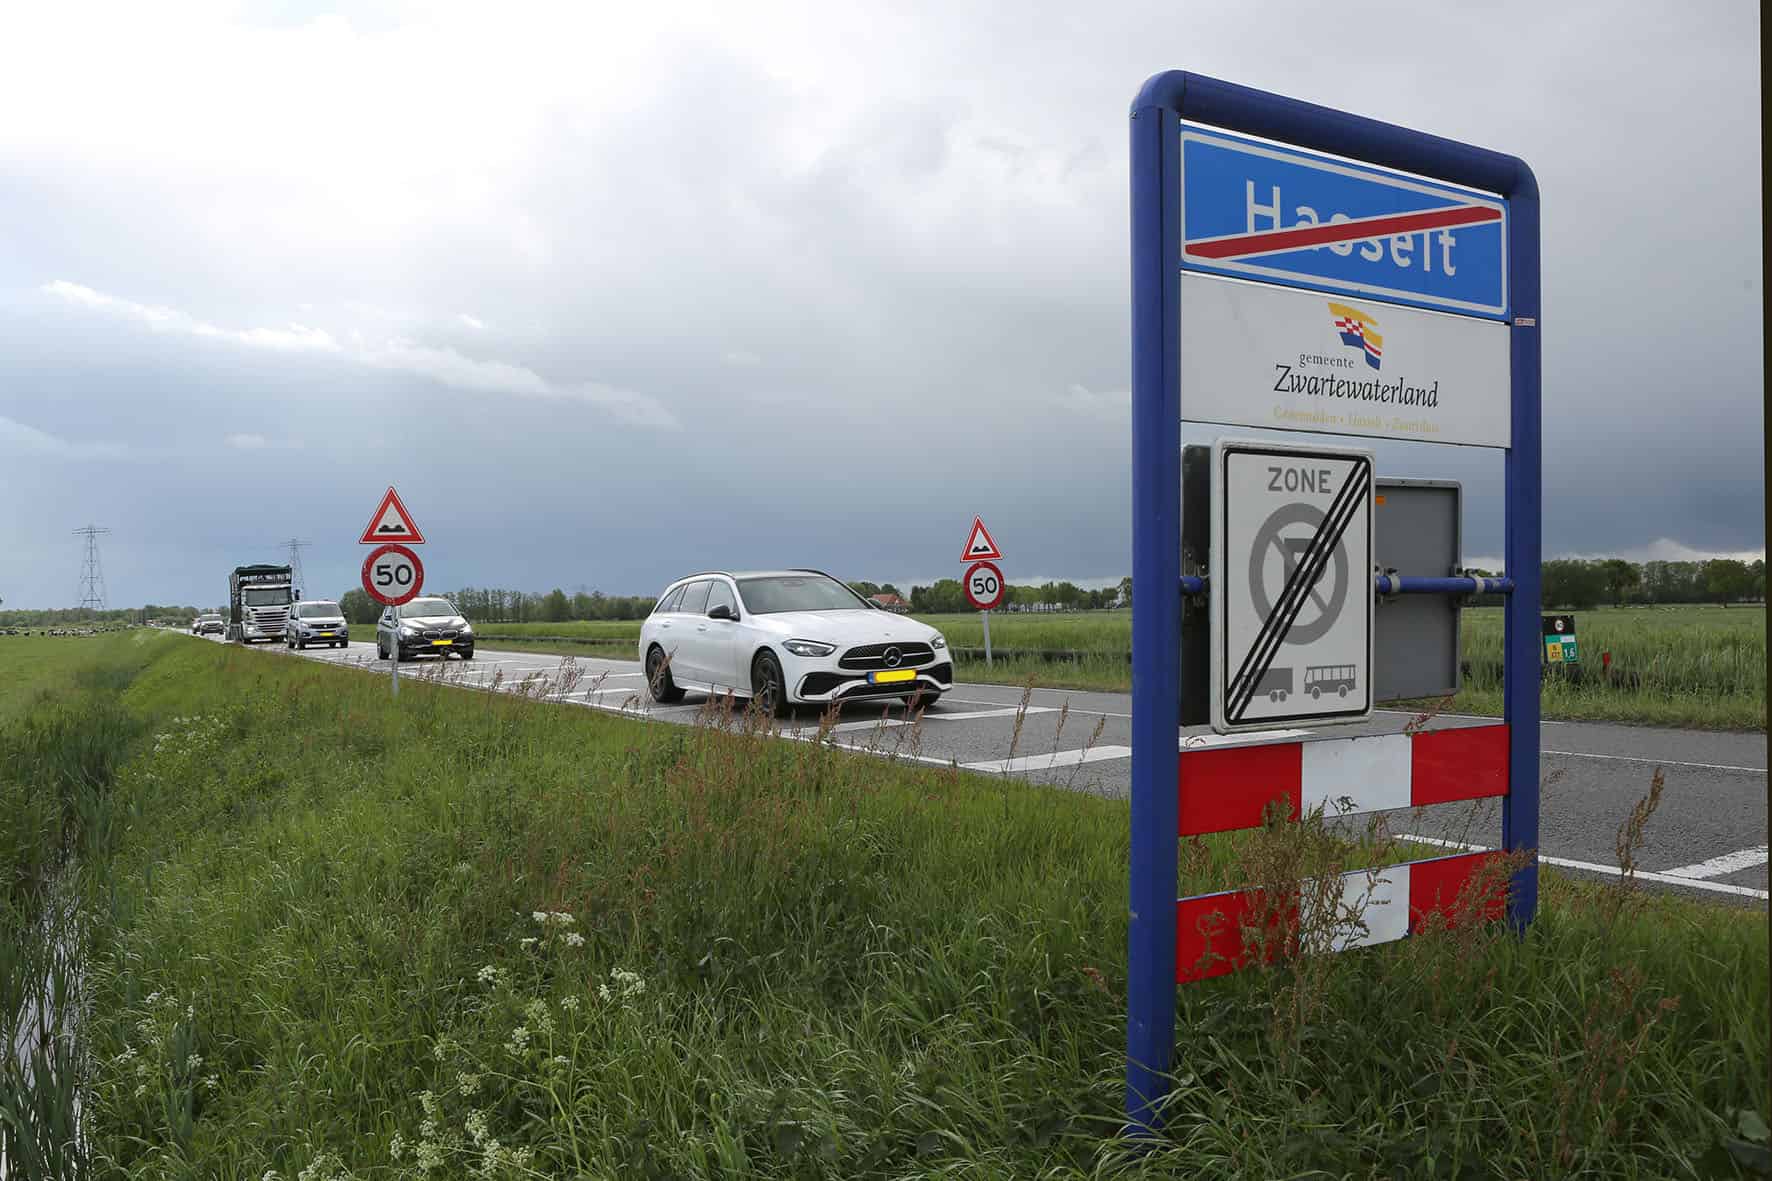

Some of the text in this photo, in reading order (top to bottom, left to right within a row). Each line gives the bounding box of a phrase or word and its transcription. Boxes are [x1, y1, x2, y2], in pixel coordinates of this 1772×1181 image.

[1299, 353, 1354, 368] gemeente
[1273, 364, 1439, 408] Zwartewaterland
[1268, 467, 1331, 494] ZONE
[376, 564, 412, 586] 50
[973, 577, 997, 595] 50
